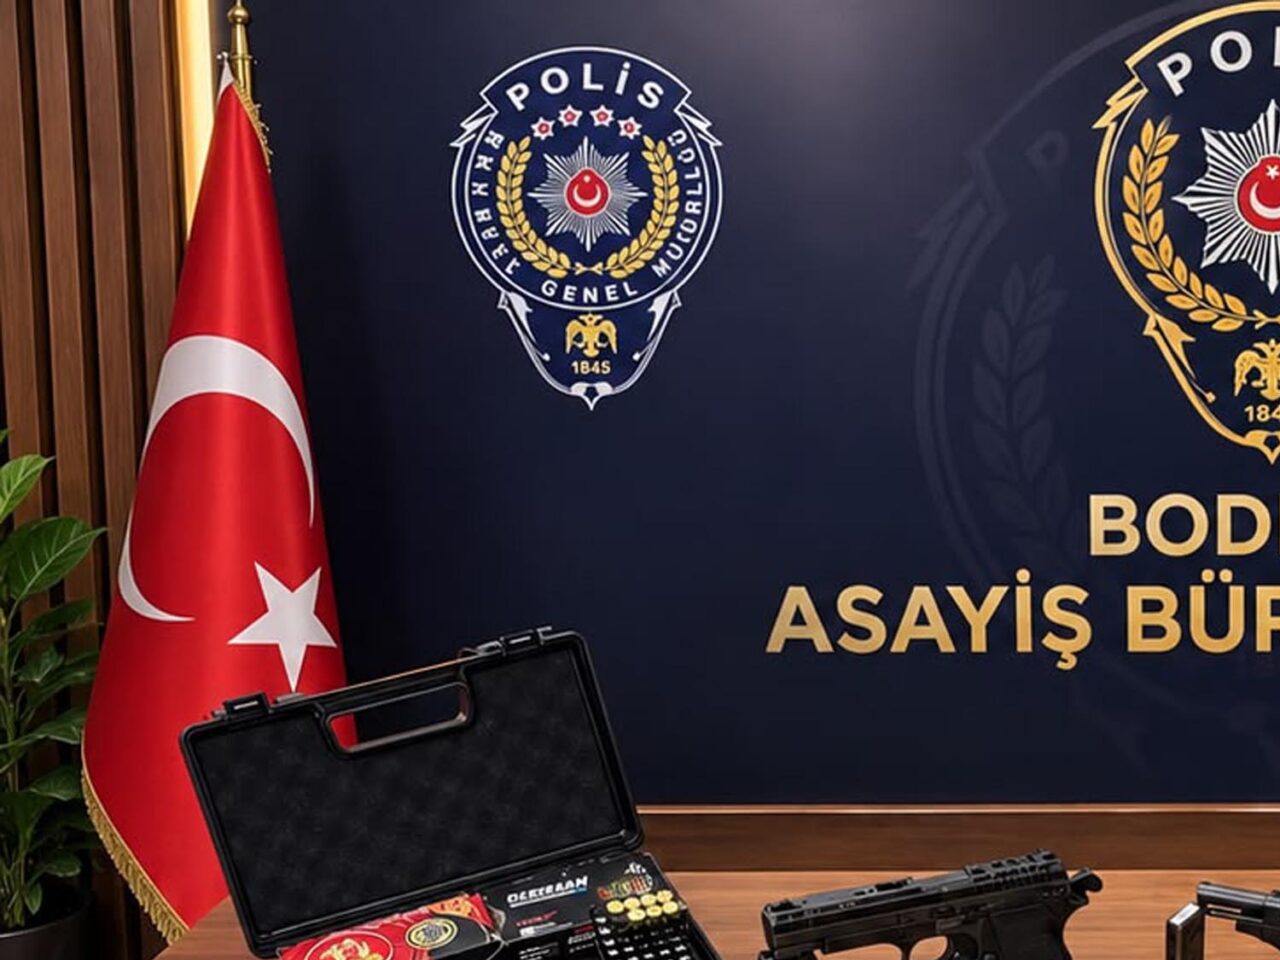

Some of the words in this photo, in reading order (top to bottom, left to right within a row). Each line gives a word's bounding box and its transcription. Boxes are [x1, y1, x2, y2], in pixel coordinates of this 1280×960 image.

[505, 61, 665, 112] POLİS
[541, 278, 639, 303] GENEL
[766, 568, 1092, 671] ASAYİŞ
